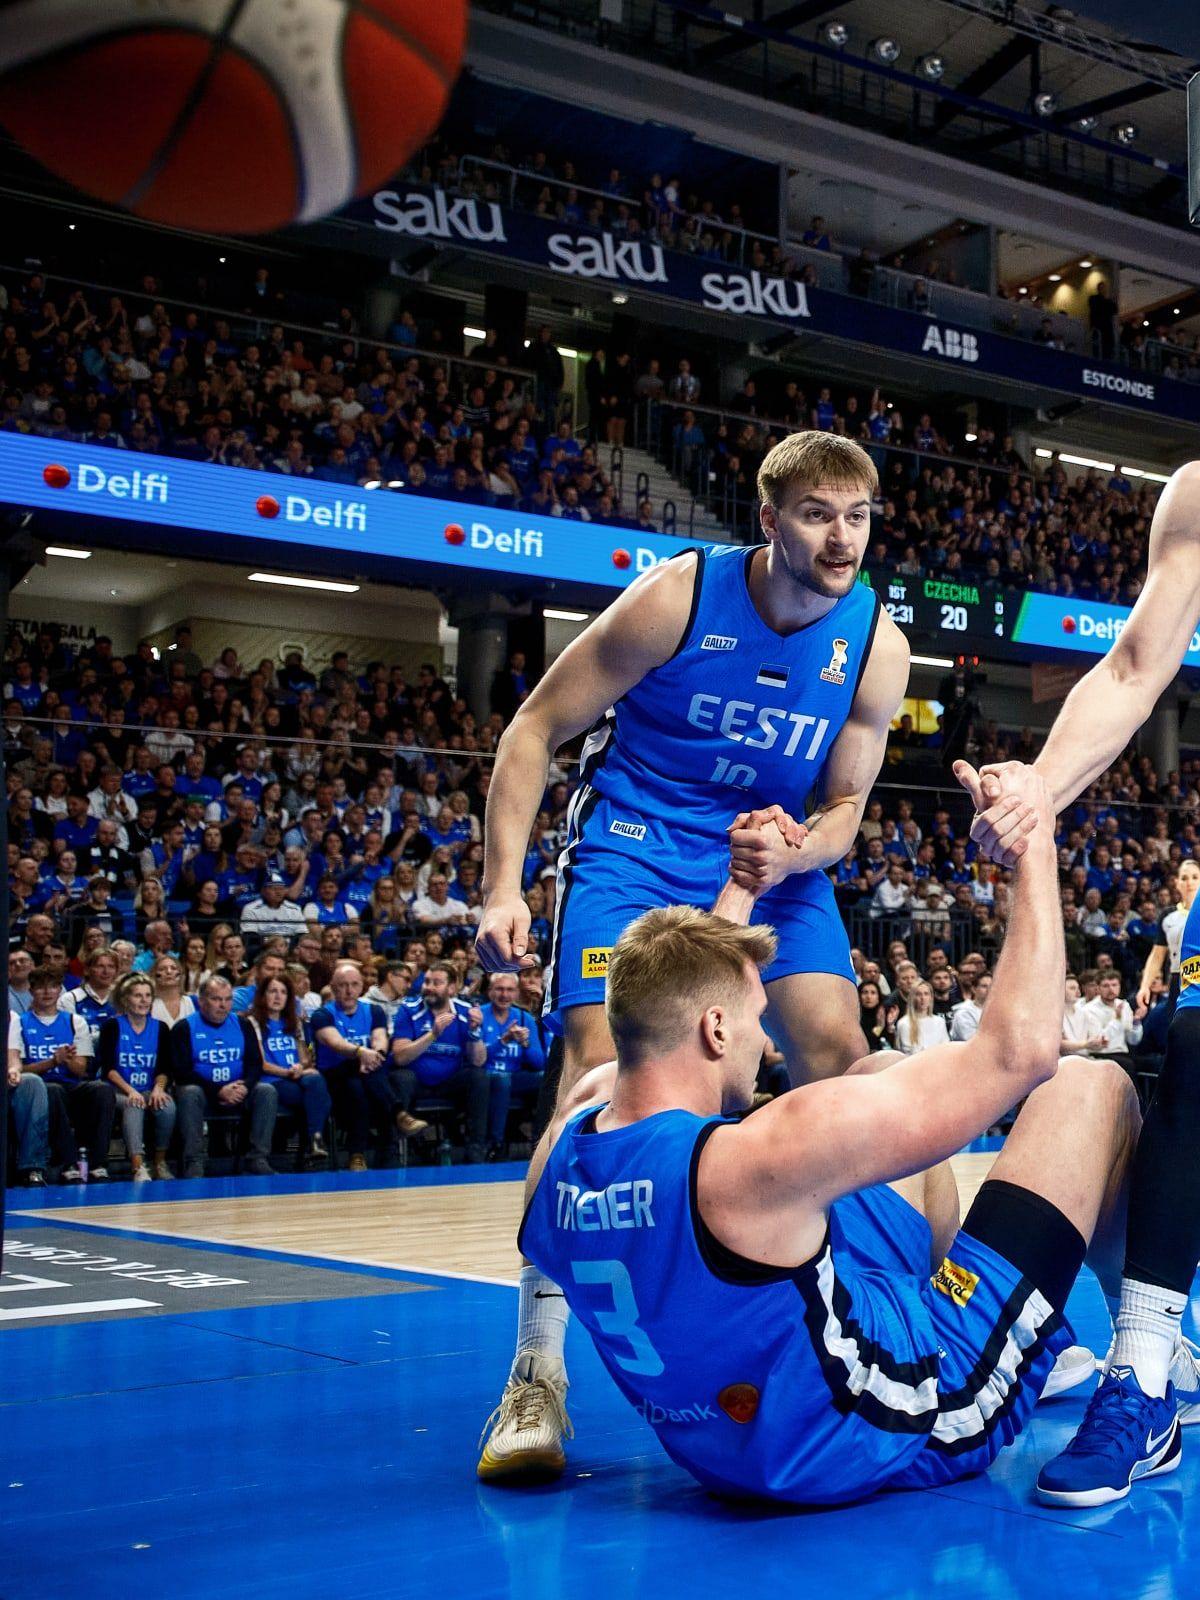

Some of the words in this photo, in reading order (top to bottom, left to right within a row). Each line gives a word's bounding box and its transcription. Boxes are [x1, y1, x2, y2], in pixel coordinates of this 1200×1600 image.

[373, 189, 507, 243] saku
[548, 232, 668, 283] saku
[702, 270, 811, 317] saku
[922, 325, 979, 362] ABB
[1083, 368, 1155, 400] ESTCONDE
[77, 465, 168, 503] Delfi
[286, 496, 366, 532] Delfi
[470, 524, 544, 558] Delfi
[888, 585, 907, 600] 1ST
[924, 580, 980, 605] CZECHIA
[940, 604, 968, 631] 20
[995, 623, 1004, 637] 4
[704, 636, 735, 649] BALLZY
[687, 693, 829, 761] EESTI
[613, 822, 644, 838] BALLZY
[119, 1052, 157, 1068] EESTI
[571, 1260, 665, 1377] 3
